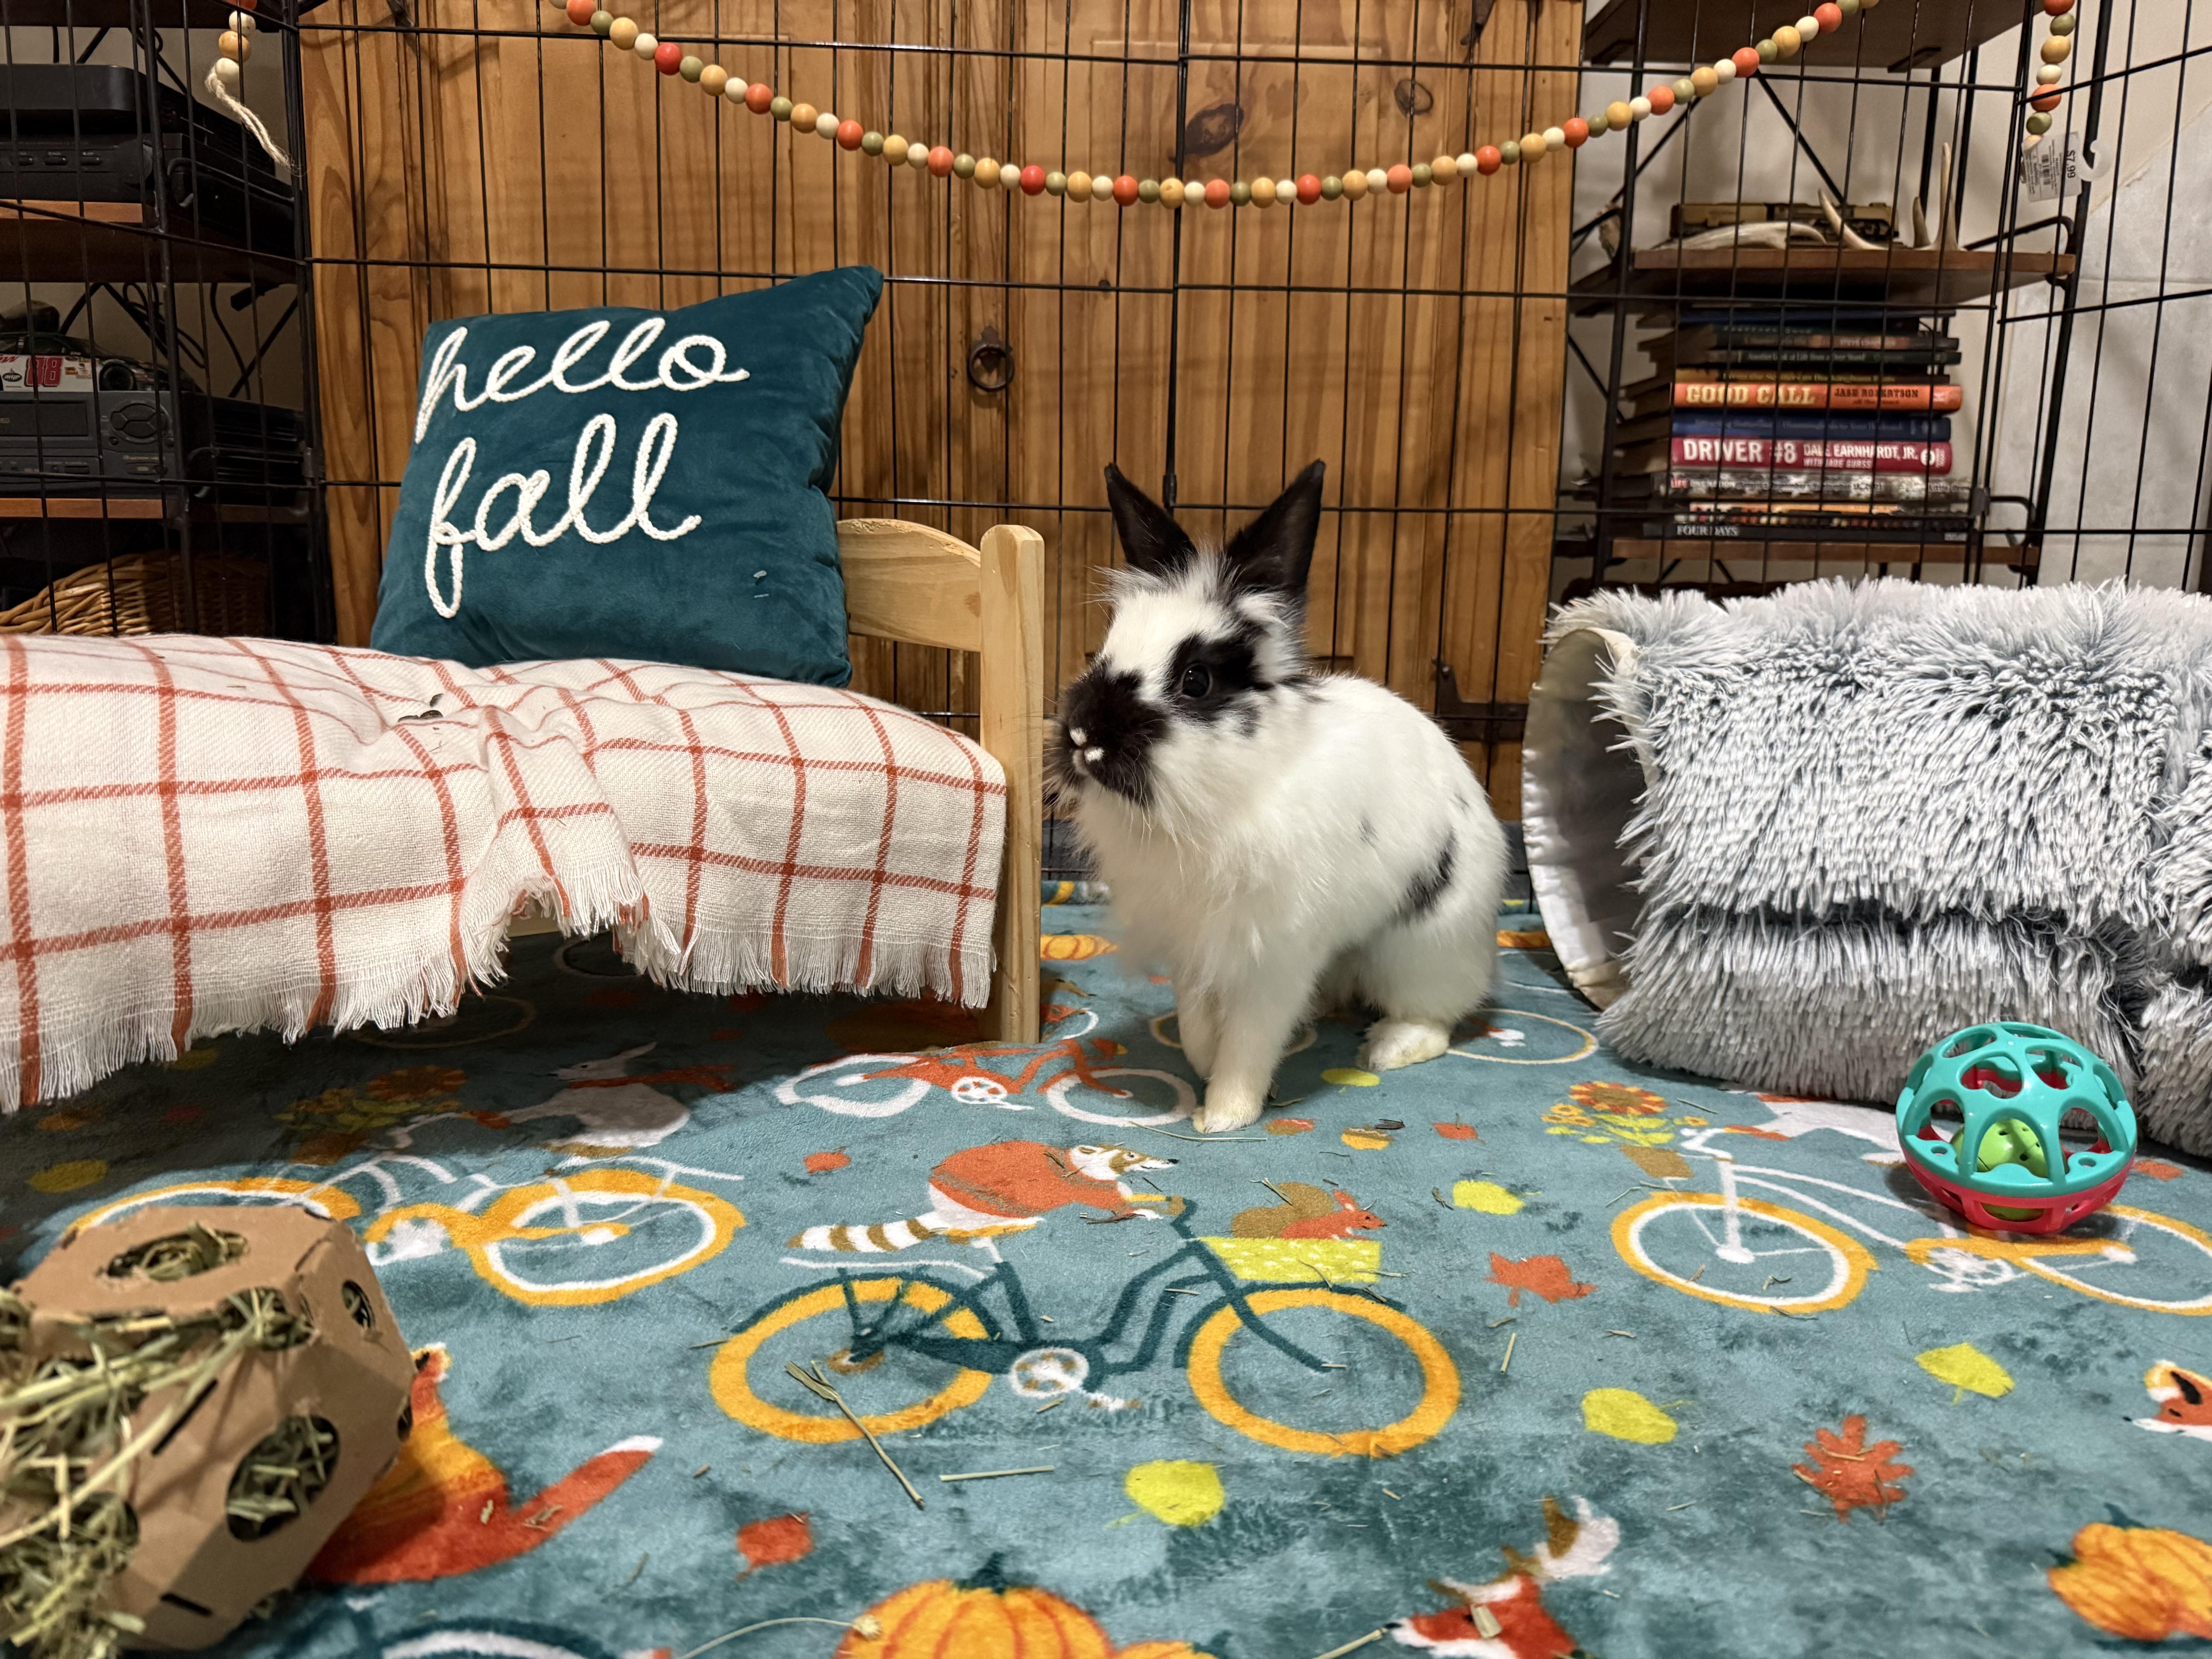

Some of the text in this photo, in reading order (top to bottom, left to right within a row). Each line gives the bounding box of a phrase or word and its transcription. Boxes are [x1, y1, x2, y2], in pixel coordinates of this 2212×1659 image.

[2066, 149, 2076, 179] $7.99
[415, 317, 750, 444] hello
[1686, 385, 1815, 405] GOOD CALL
[1683, 438, 1797, 464] DRIVER #8
[1803, 443, 1833, 457] DALE
[1833, 444, 1901, 461] EARNHARDT,
[1902, 445, 1918, 460] JR.
[1671, 479, 1689, 489] LIFE
[425, 412, 702, 618] fall
[1677, 524, 1709, 536] FOUR
